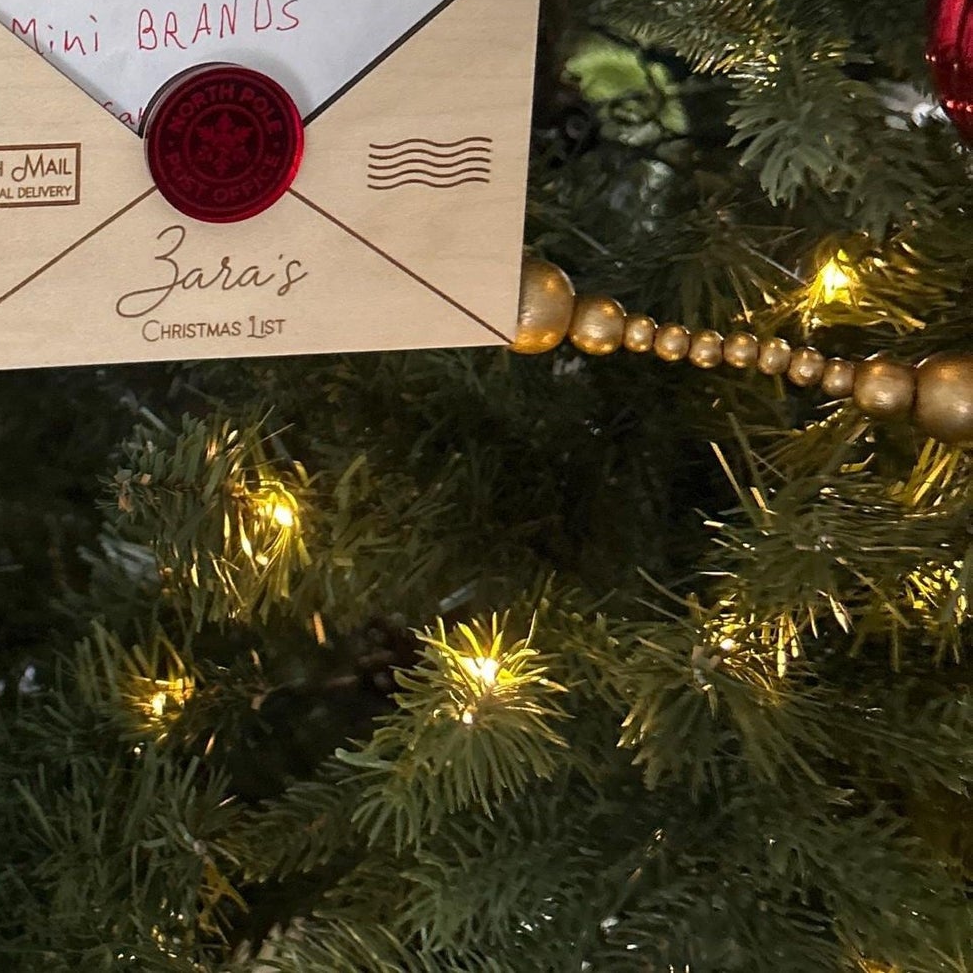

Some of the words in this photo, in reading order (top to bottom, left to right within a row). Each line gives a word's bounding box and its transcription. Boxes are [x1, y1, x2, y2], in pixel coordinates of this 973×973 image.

[168, 84, 235, 133] NORTH
[240, 87, 283, 134] POLE
[10, 152, 73, 183] MAIL
[17, 184, 73, 200] DELIVERY
[115, 224, 309, 319] Zara's
[141, 319, 243, 343] CHRISTMAS
[246, 314, 287, 340] LIST
